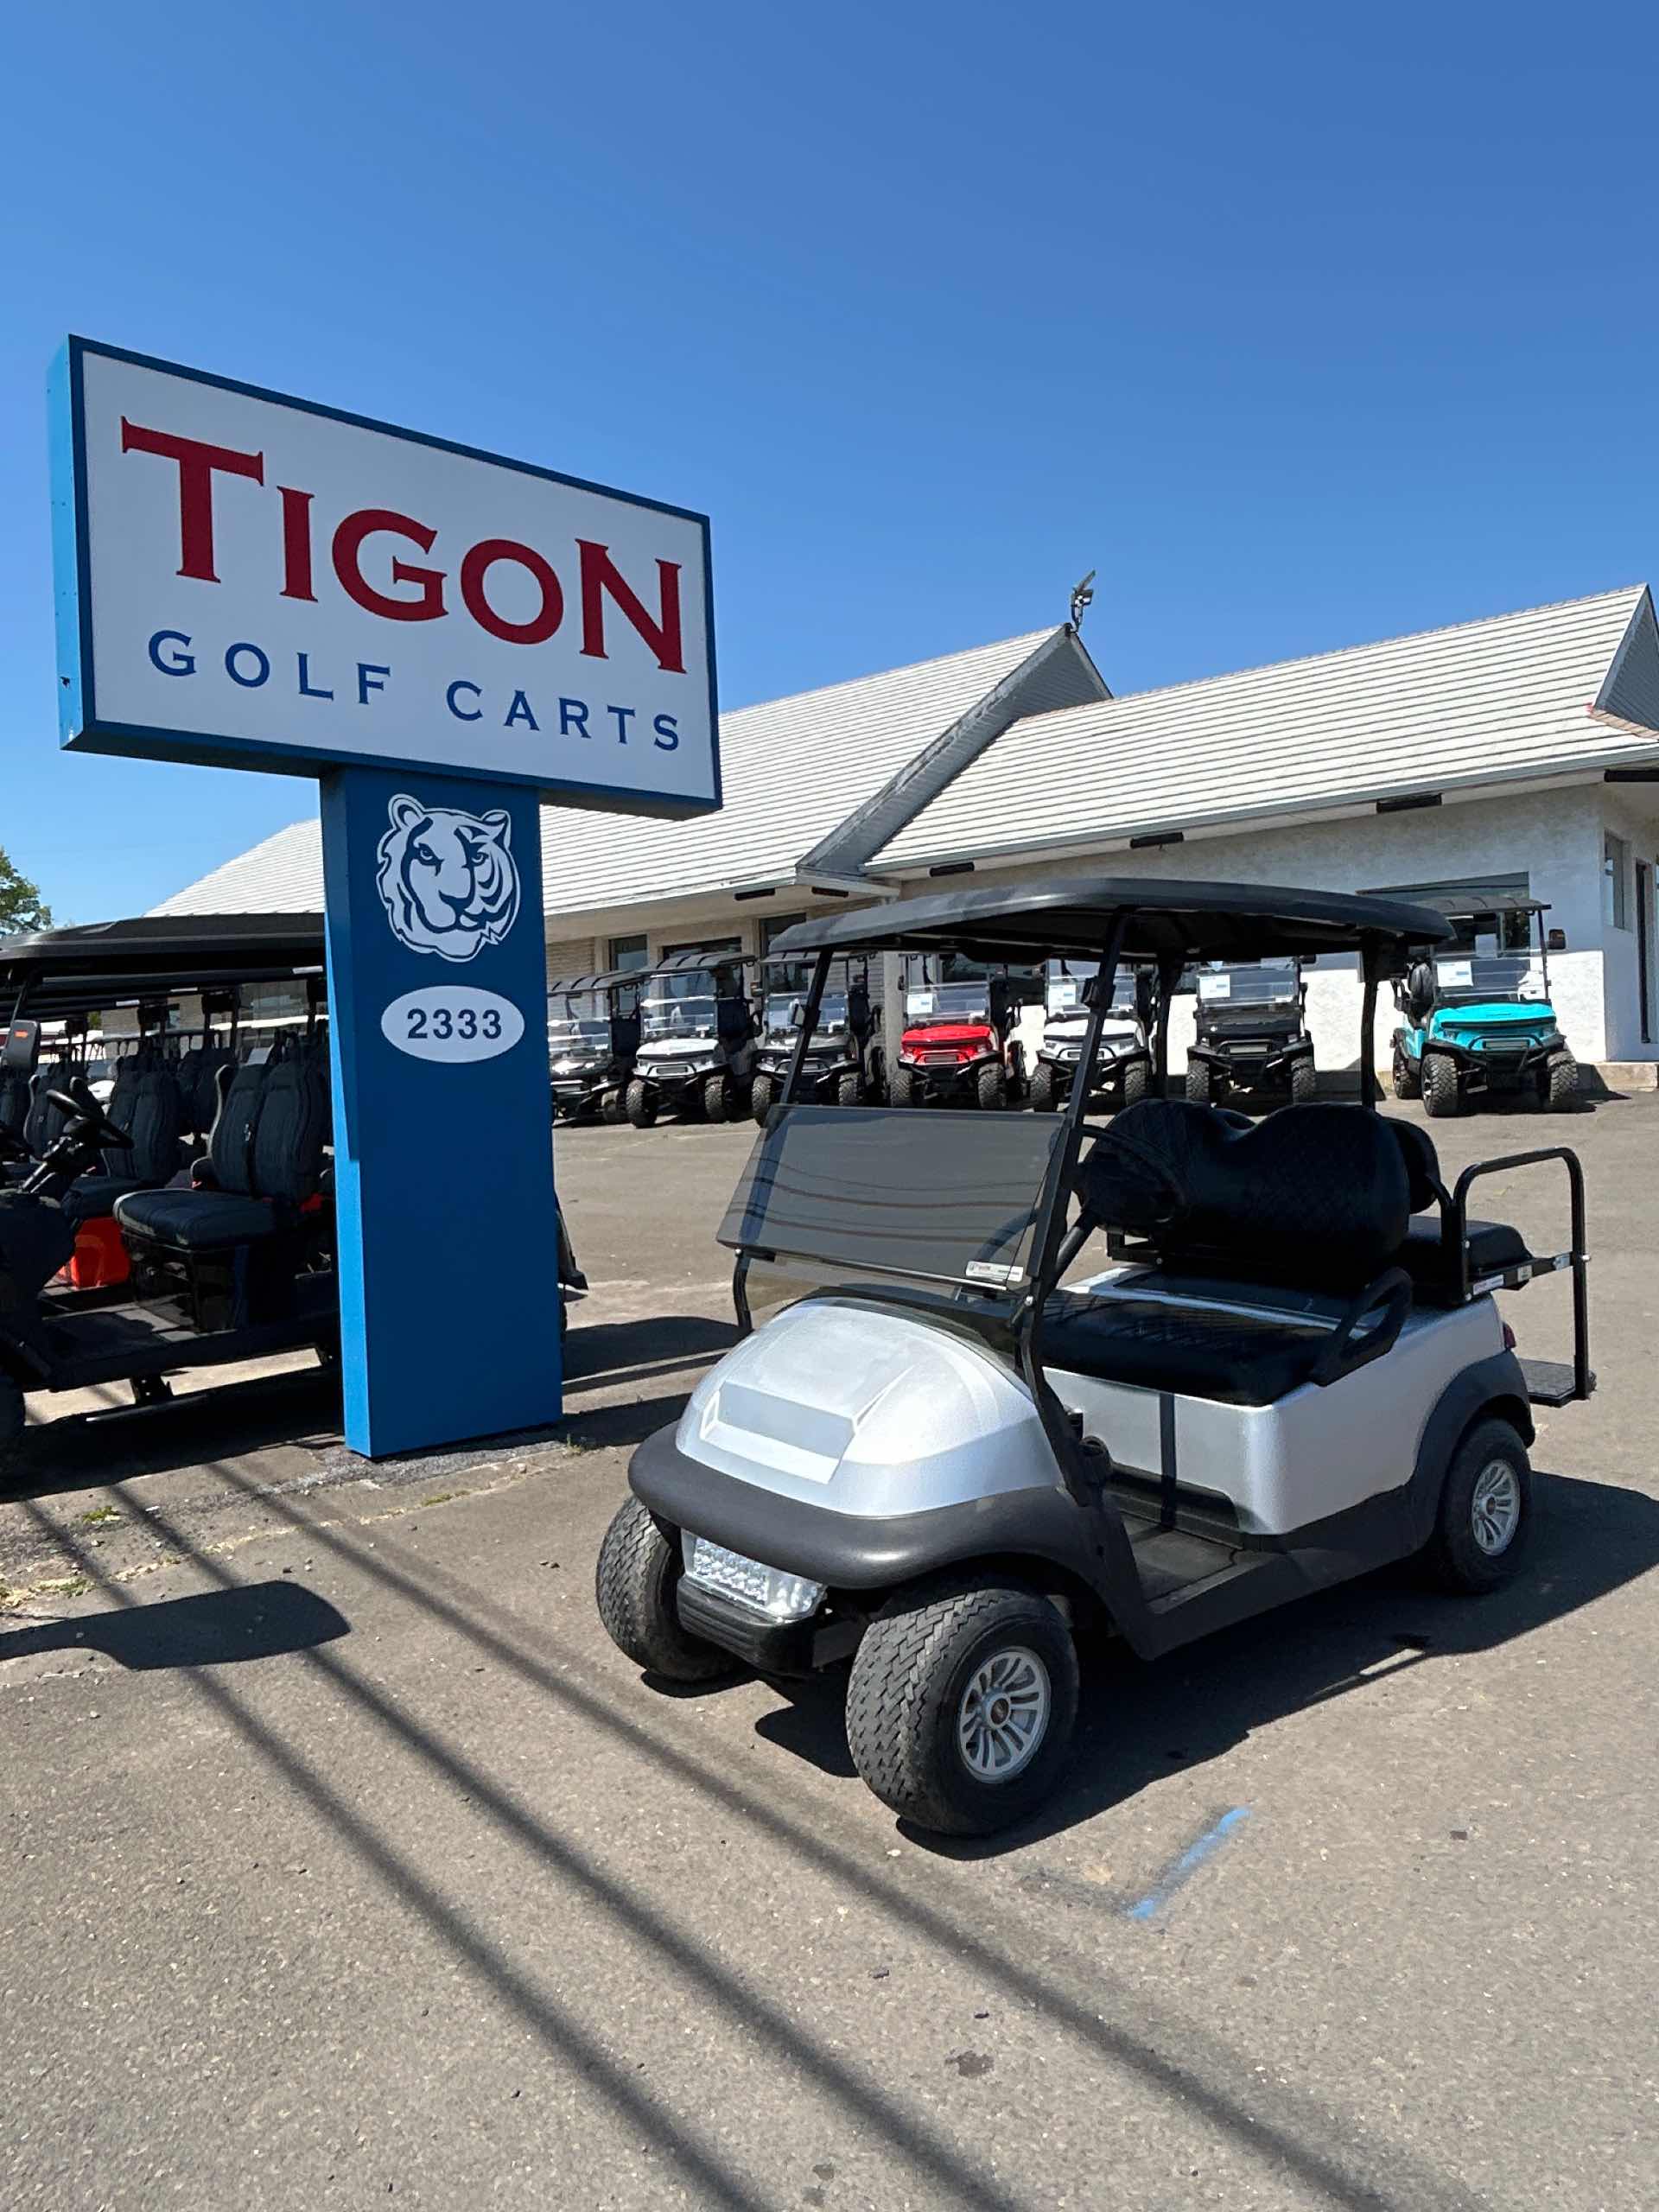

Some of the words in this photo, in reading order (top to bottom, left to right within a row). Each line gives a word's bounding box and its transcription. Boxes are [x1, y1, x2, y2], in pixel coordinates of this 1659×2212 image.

[121, 416, 687, 674] TIGON
[148, 629, 391, 705] GOLF
[446, 680, 679, 752] CARTS
[407, 1008, 502, 1039] 2333
